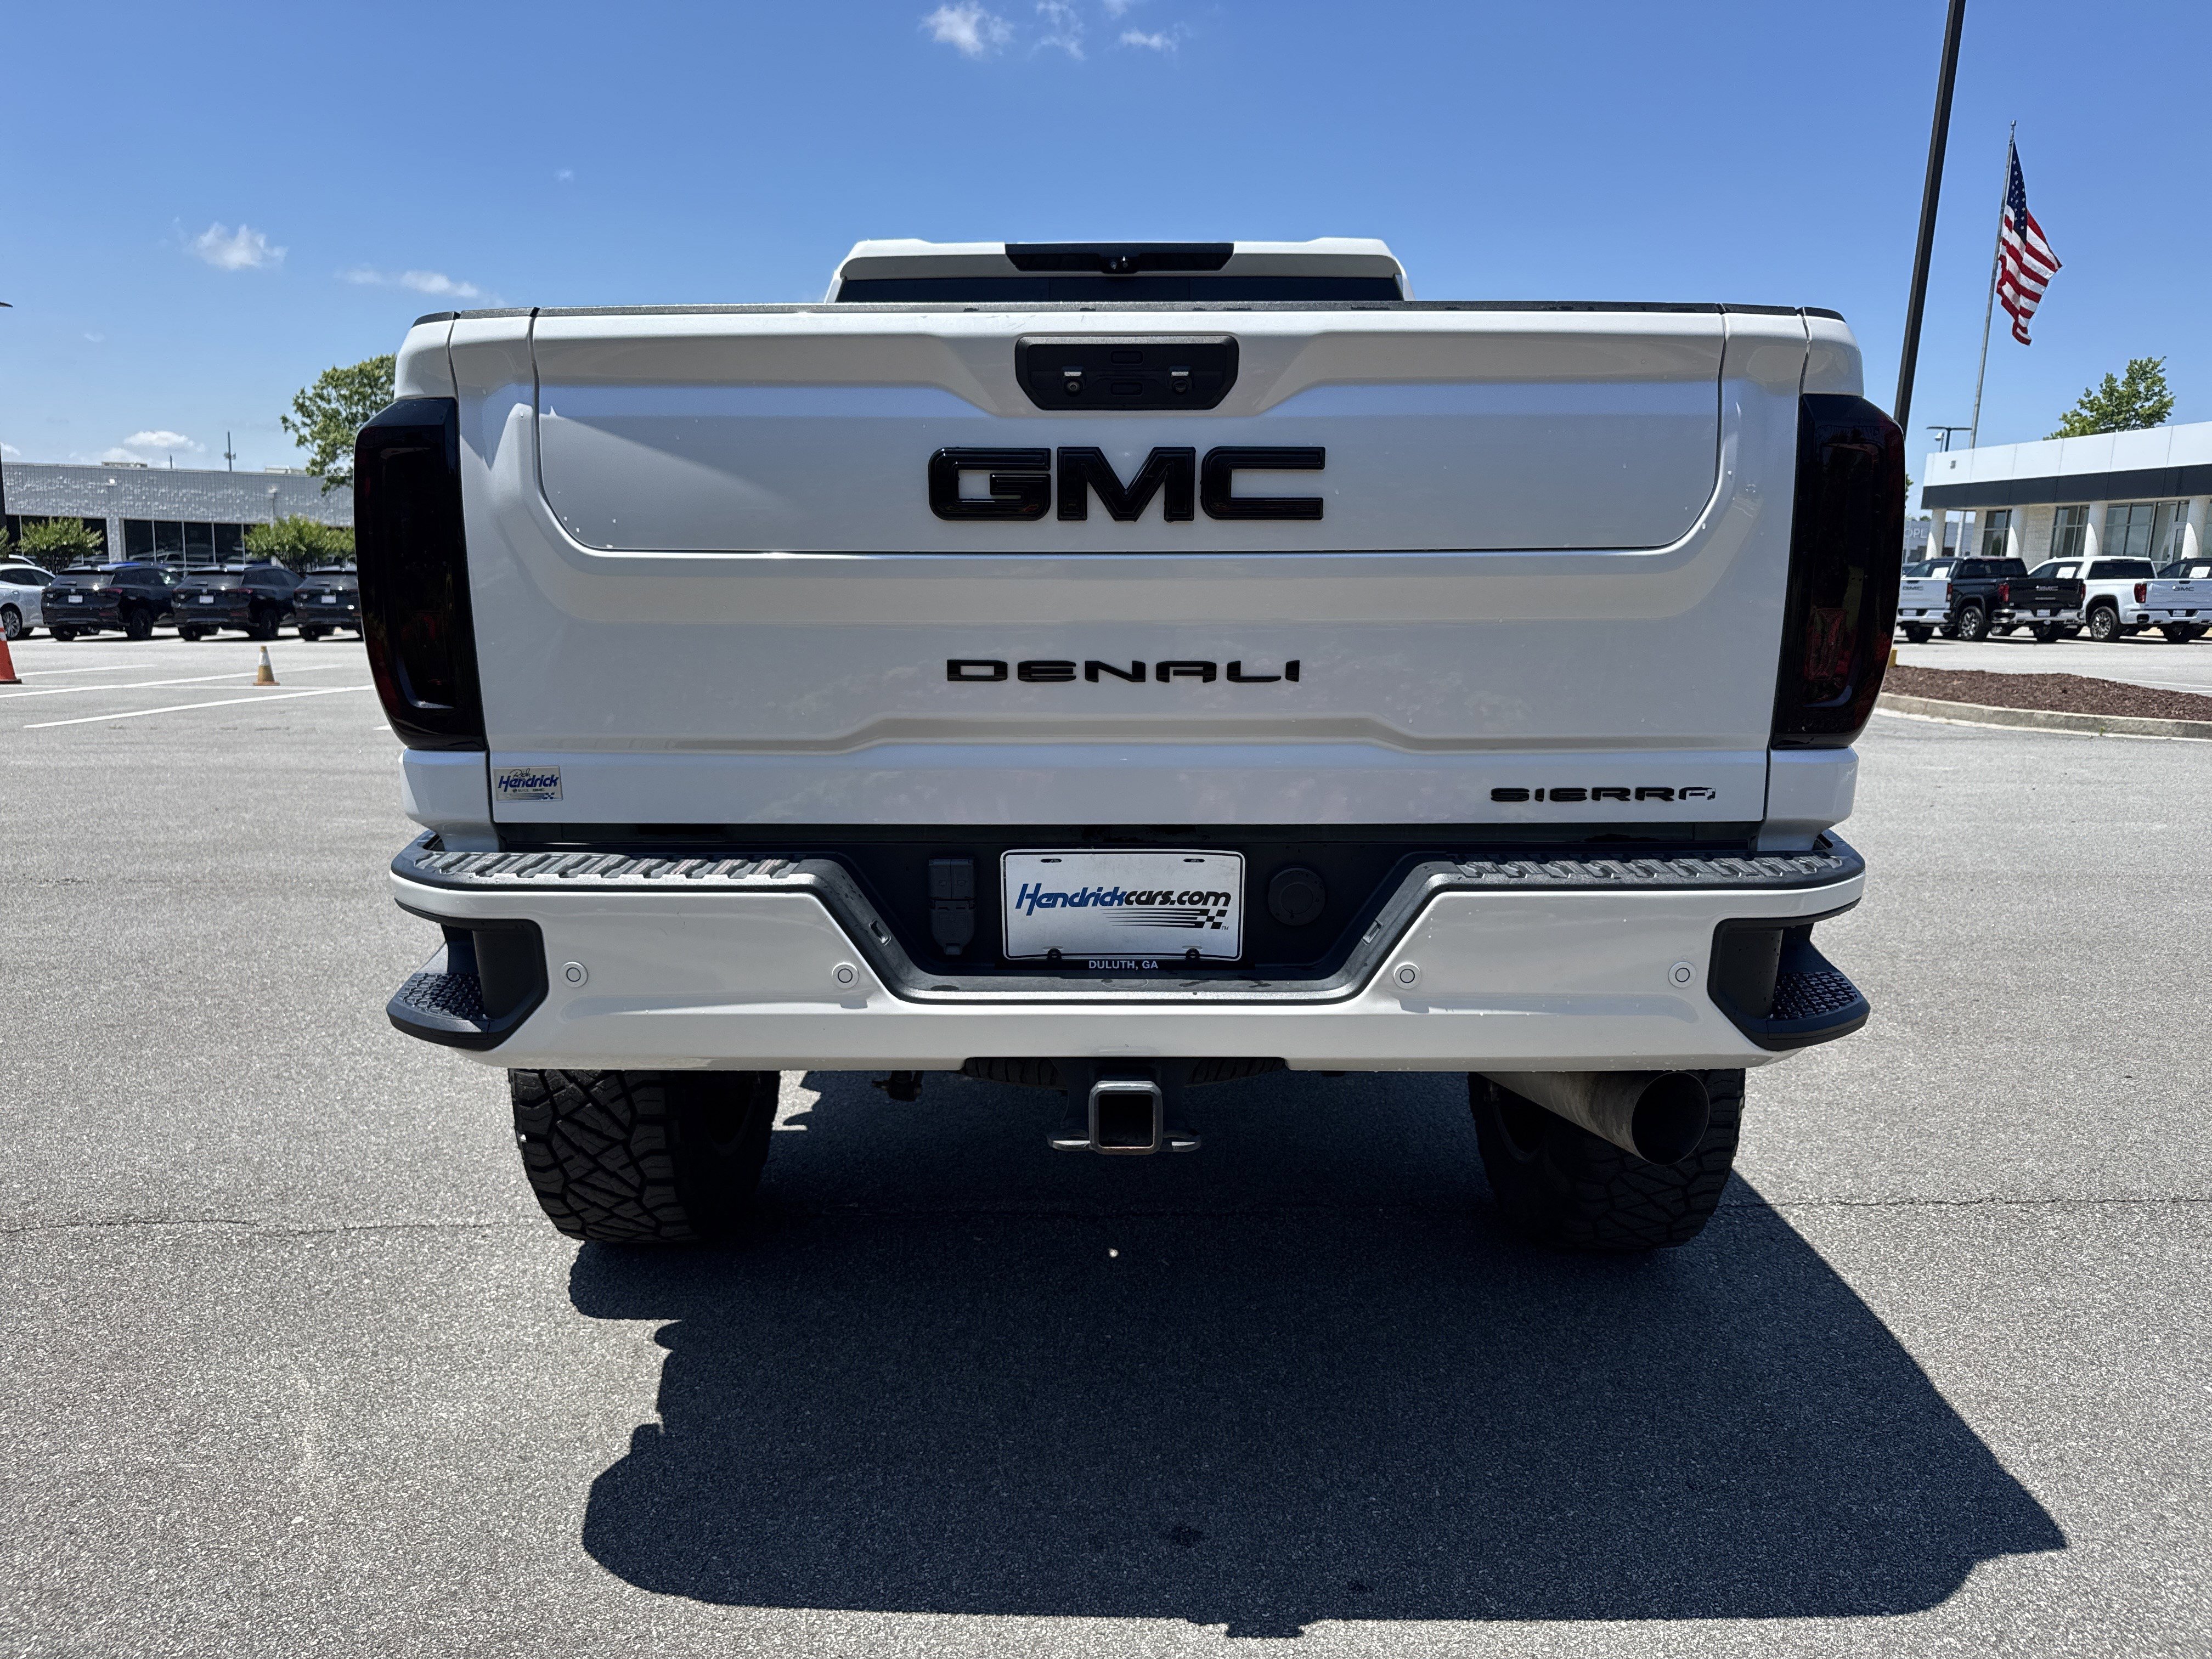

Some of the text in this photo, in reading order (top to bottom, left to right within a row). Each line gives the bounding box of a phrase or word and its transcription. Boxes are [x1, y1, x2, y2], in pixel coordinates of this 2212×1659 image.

[928, 447, 1325, 522] GMC
[947, 659, 1300, 682] DENALI
[498, 774, 559, 792] Hendrick
[1491, 787, 1716, 802] SIERRA
[1015, 883, 1231, 916] Hendrickcars.com
[1088, 960, 1159, 970] DULUTH, GA
